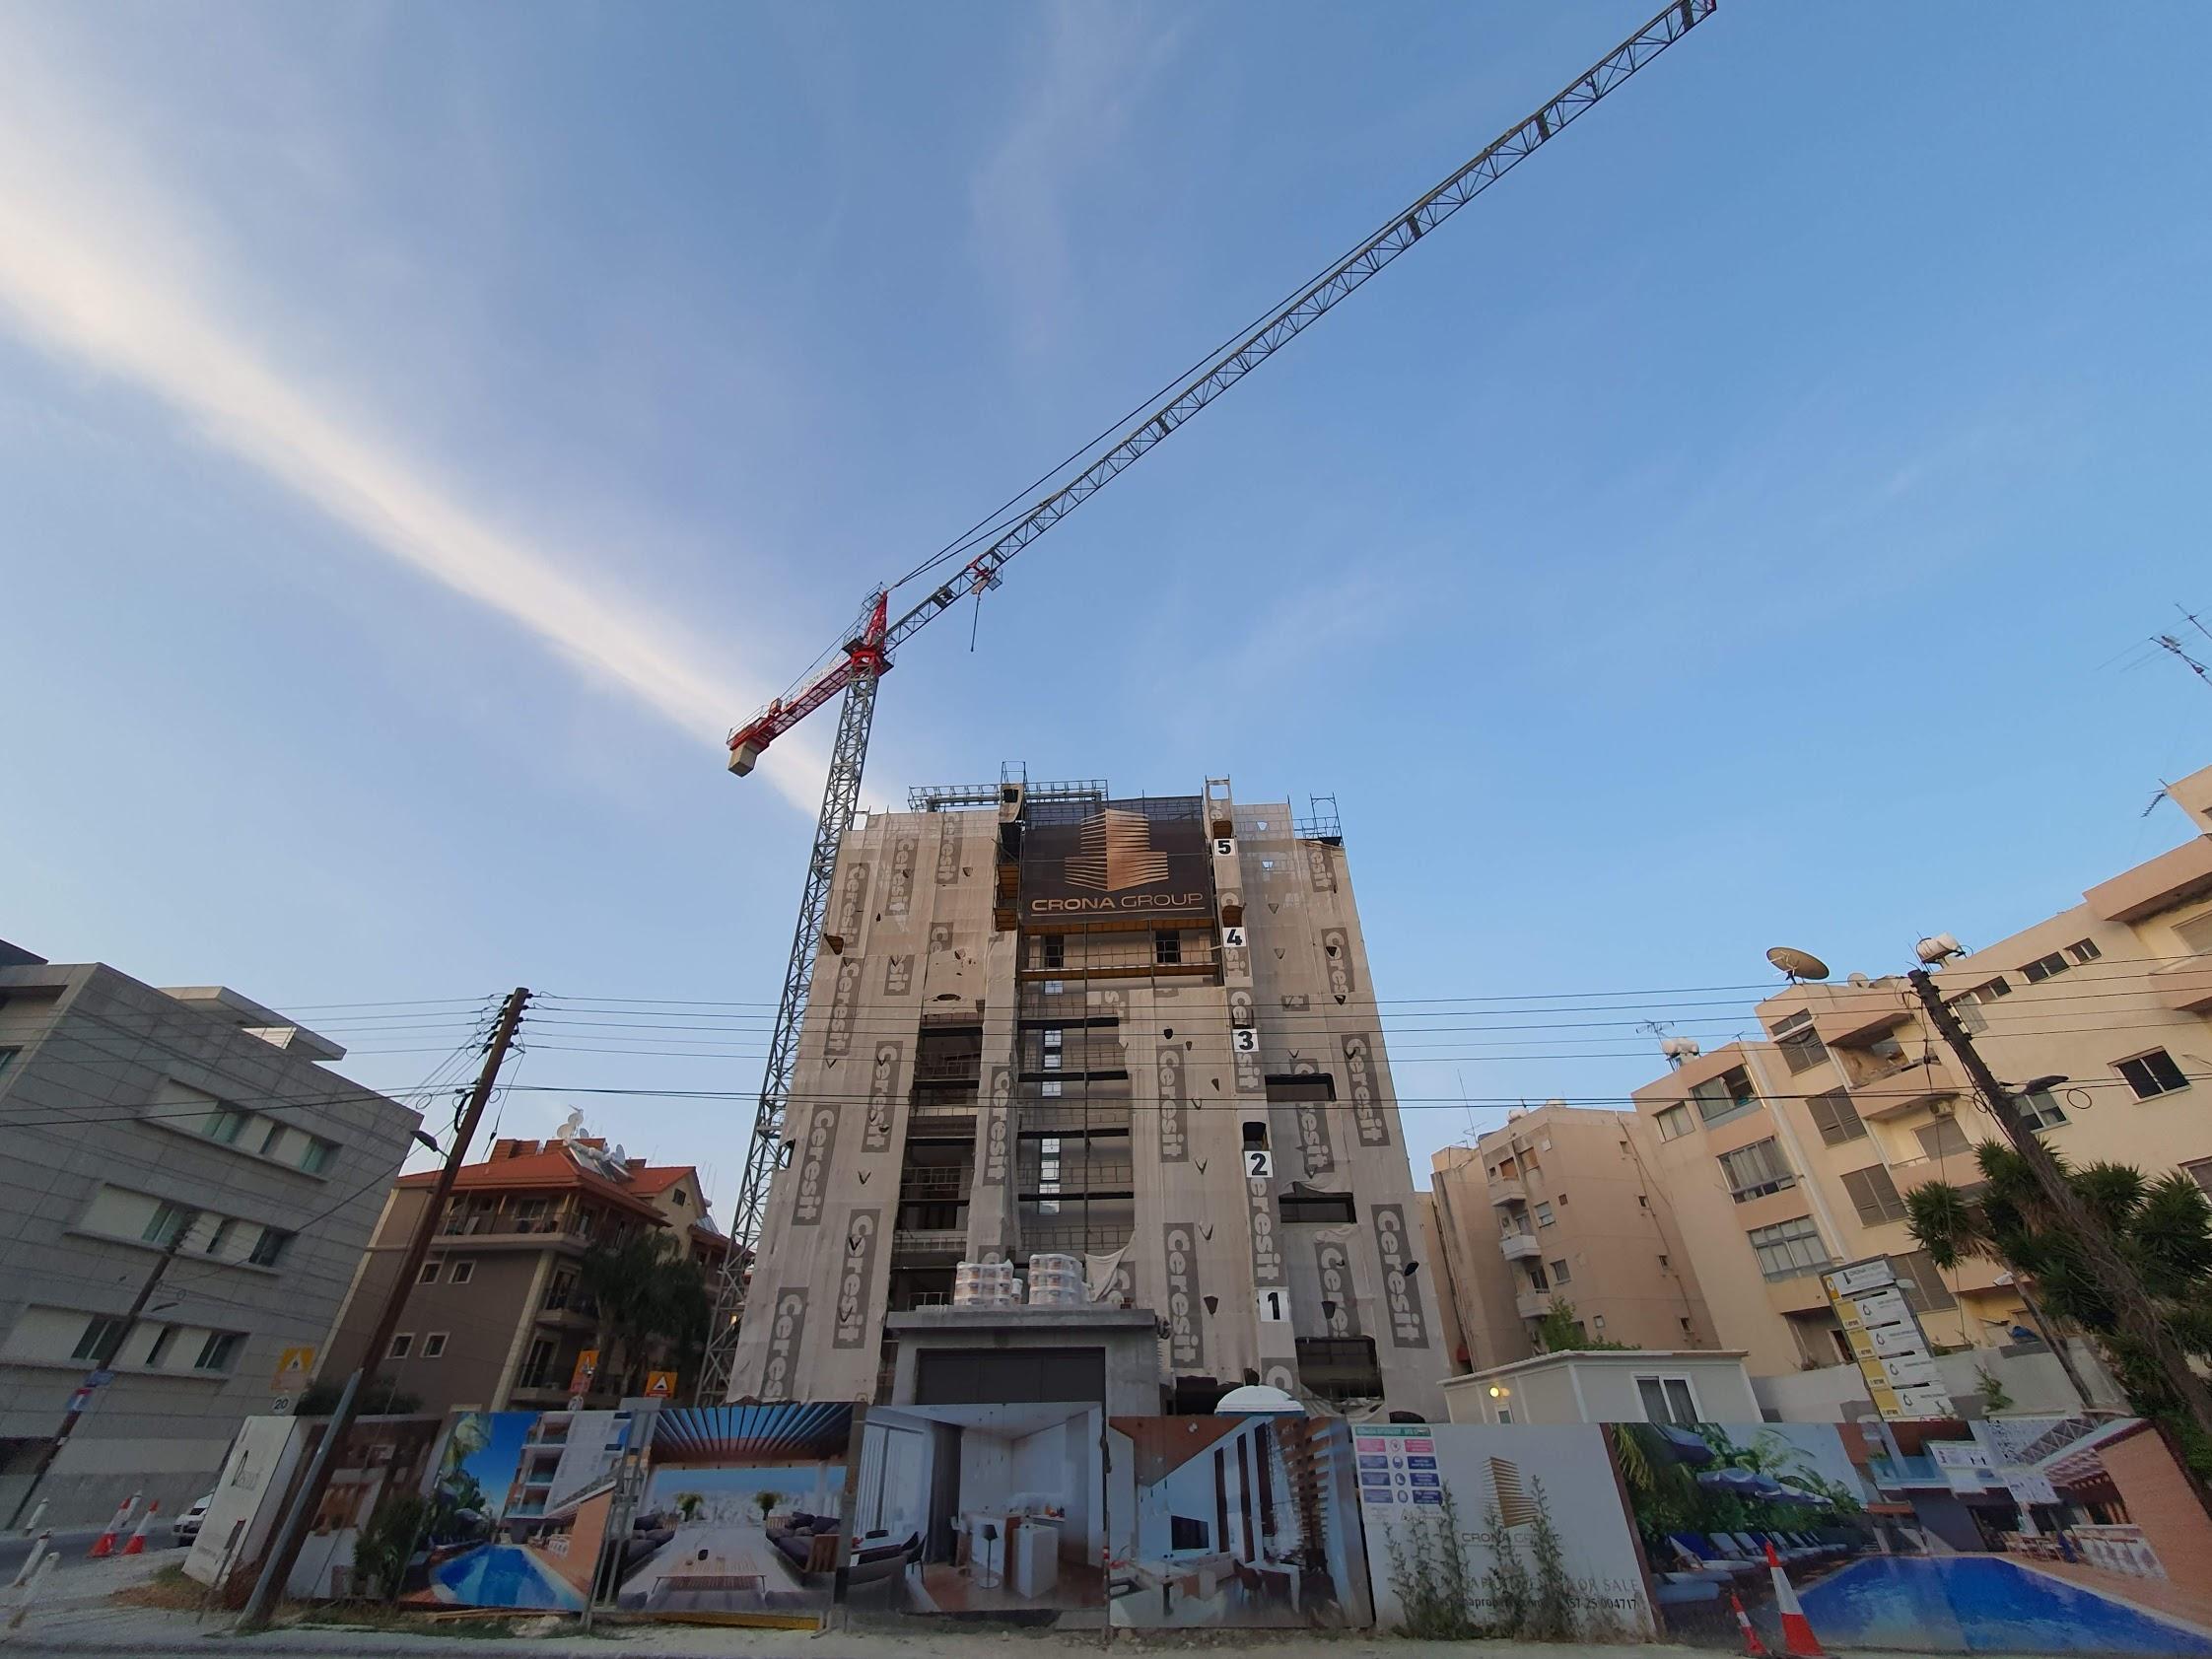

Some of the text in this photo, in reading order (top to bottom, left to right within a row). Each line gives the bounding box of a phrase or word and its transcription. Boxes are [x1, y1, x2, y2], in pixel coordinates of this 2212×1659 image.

[890, 839, 914, 913] Ceresit
[1217, 840, 1231, 855] 5
[840, 865, 865, 945] Ceresit
[1030, 893, 1204, 911] CRONA GROUP
[1225, 929, 1242, 945] 4
[829, 963, 859, 1052] Ceresit
[1239, 1031, 1254, 1051] 3
[866, 1045, 897, 1148] Ceresit
[987, 1071, 1009, 1180] Ceresit
[1160, 1051, 1184, 1156] Ceresit
[1347, 1039, 1382, 1141] Ceresit
[797, 1110, 835, 1219] Ceresit
[1250, 1153, 1268, 1176] 2
[838, 1215, 874, 1343] Ceresit
[1168, 1230, 1199, 1362] Ceresit
[1267, 1292, 1281, 1321] 1
[1377, 1210, 1419, 1342] Ceresit
[274, 1398, 289, 1410] 20
[1604, 1579, 1640, 1593] SALE
